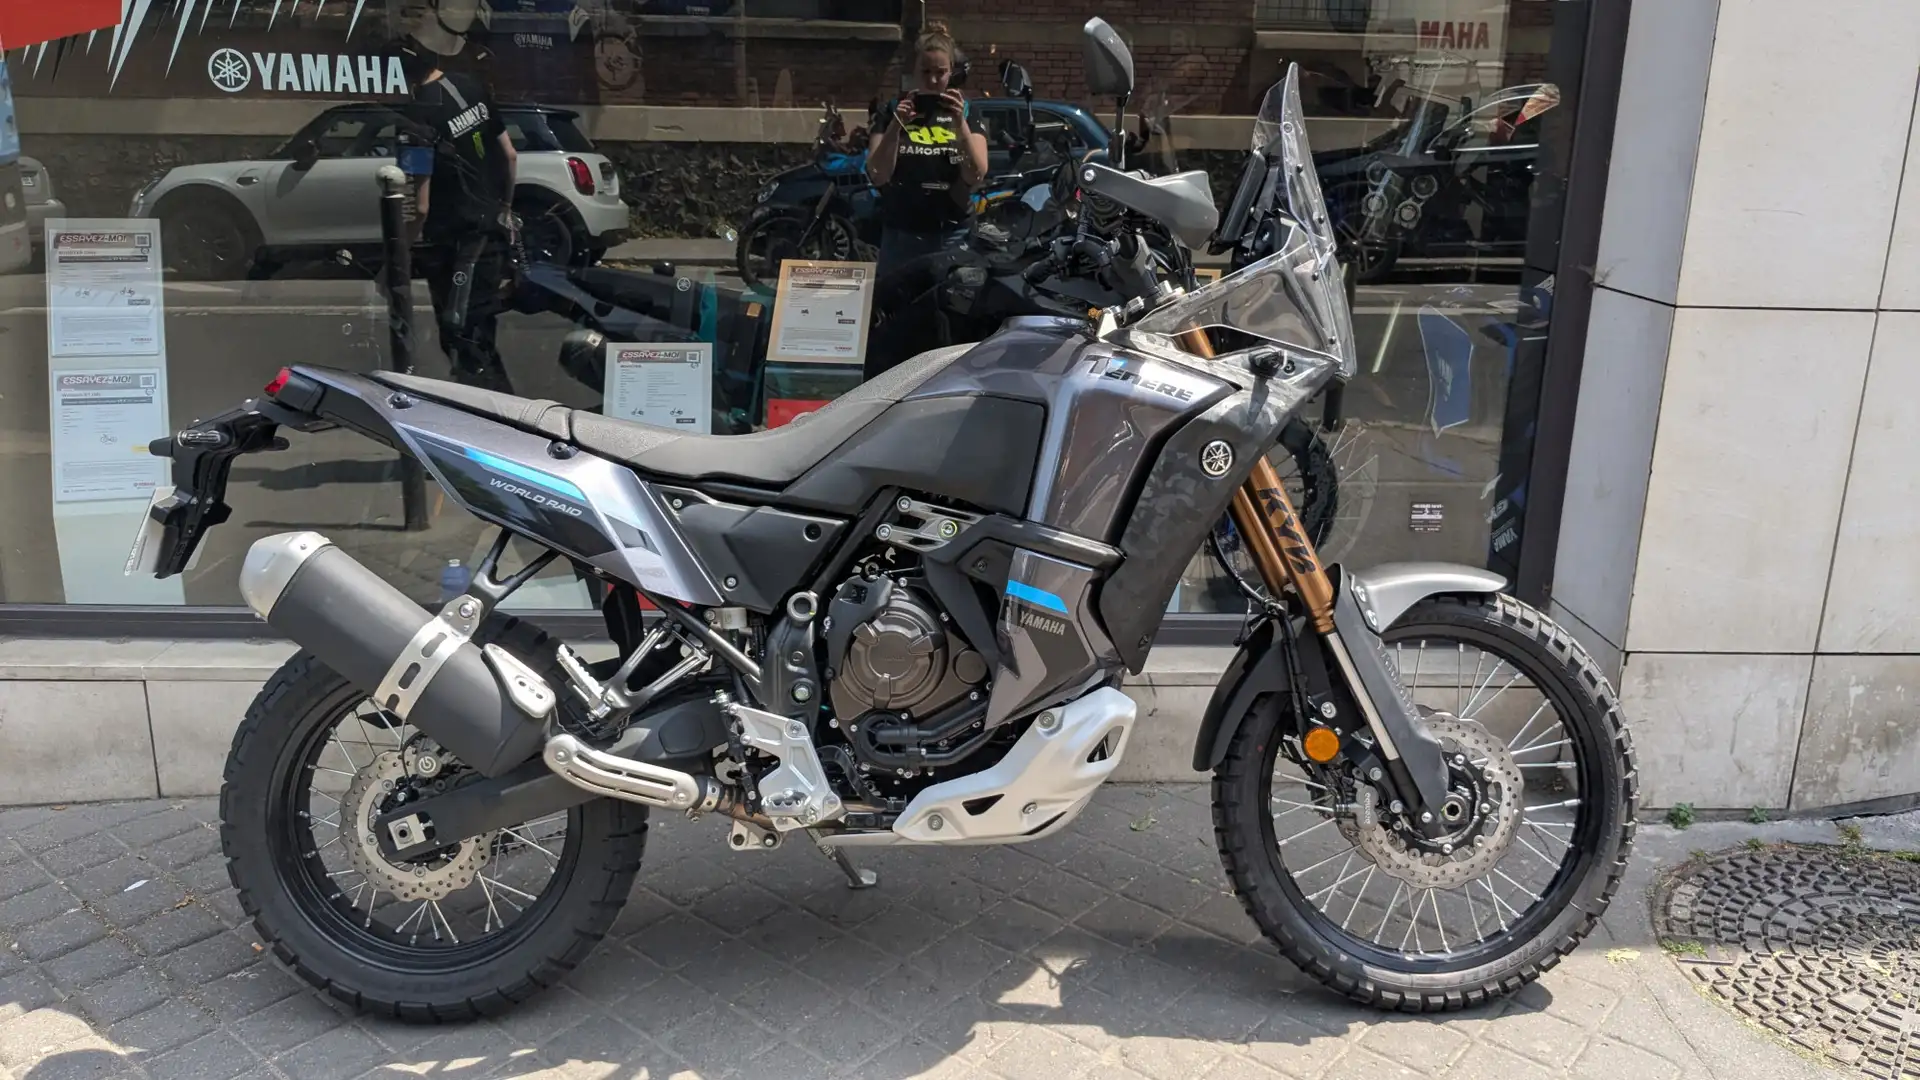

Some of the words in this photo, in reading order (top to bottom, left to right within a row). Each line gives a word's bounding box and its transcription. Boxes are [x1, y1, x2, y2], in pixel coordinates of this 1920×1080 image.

[252, 52, 408, 94] YAMAHA
[489, 478, 546, 503] WORLD
[546, 499, 582, 517] RAID
[1256, 488, 1316, 574] KYB
[1020, 610, 1065, 635] YAMAHA
